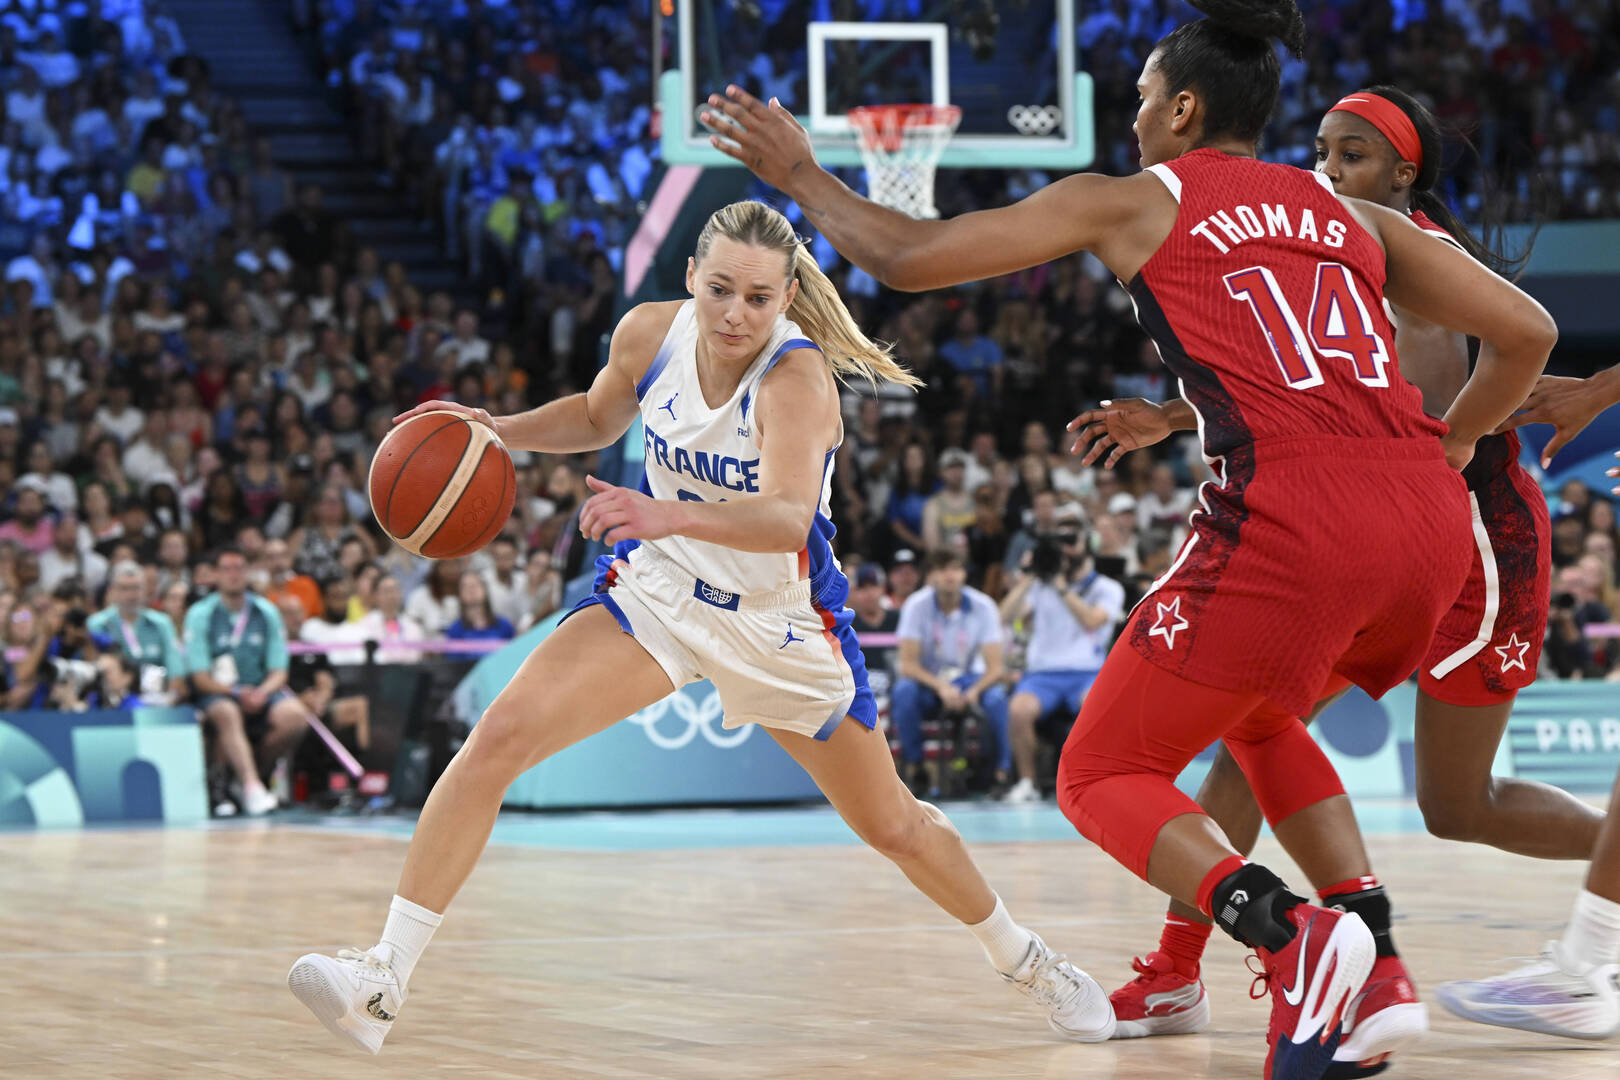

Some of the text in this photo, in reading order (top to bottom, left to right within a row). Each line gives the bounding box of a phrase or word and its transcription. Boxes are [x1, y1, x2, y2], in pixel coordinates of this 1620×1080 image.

[1189, 203, 1347, 254] THOMAS
[1222, 262, 1390, 390] 14
[645, 424, 760, 493] FRANCE
